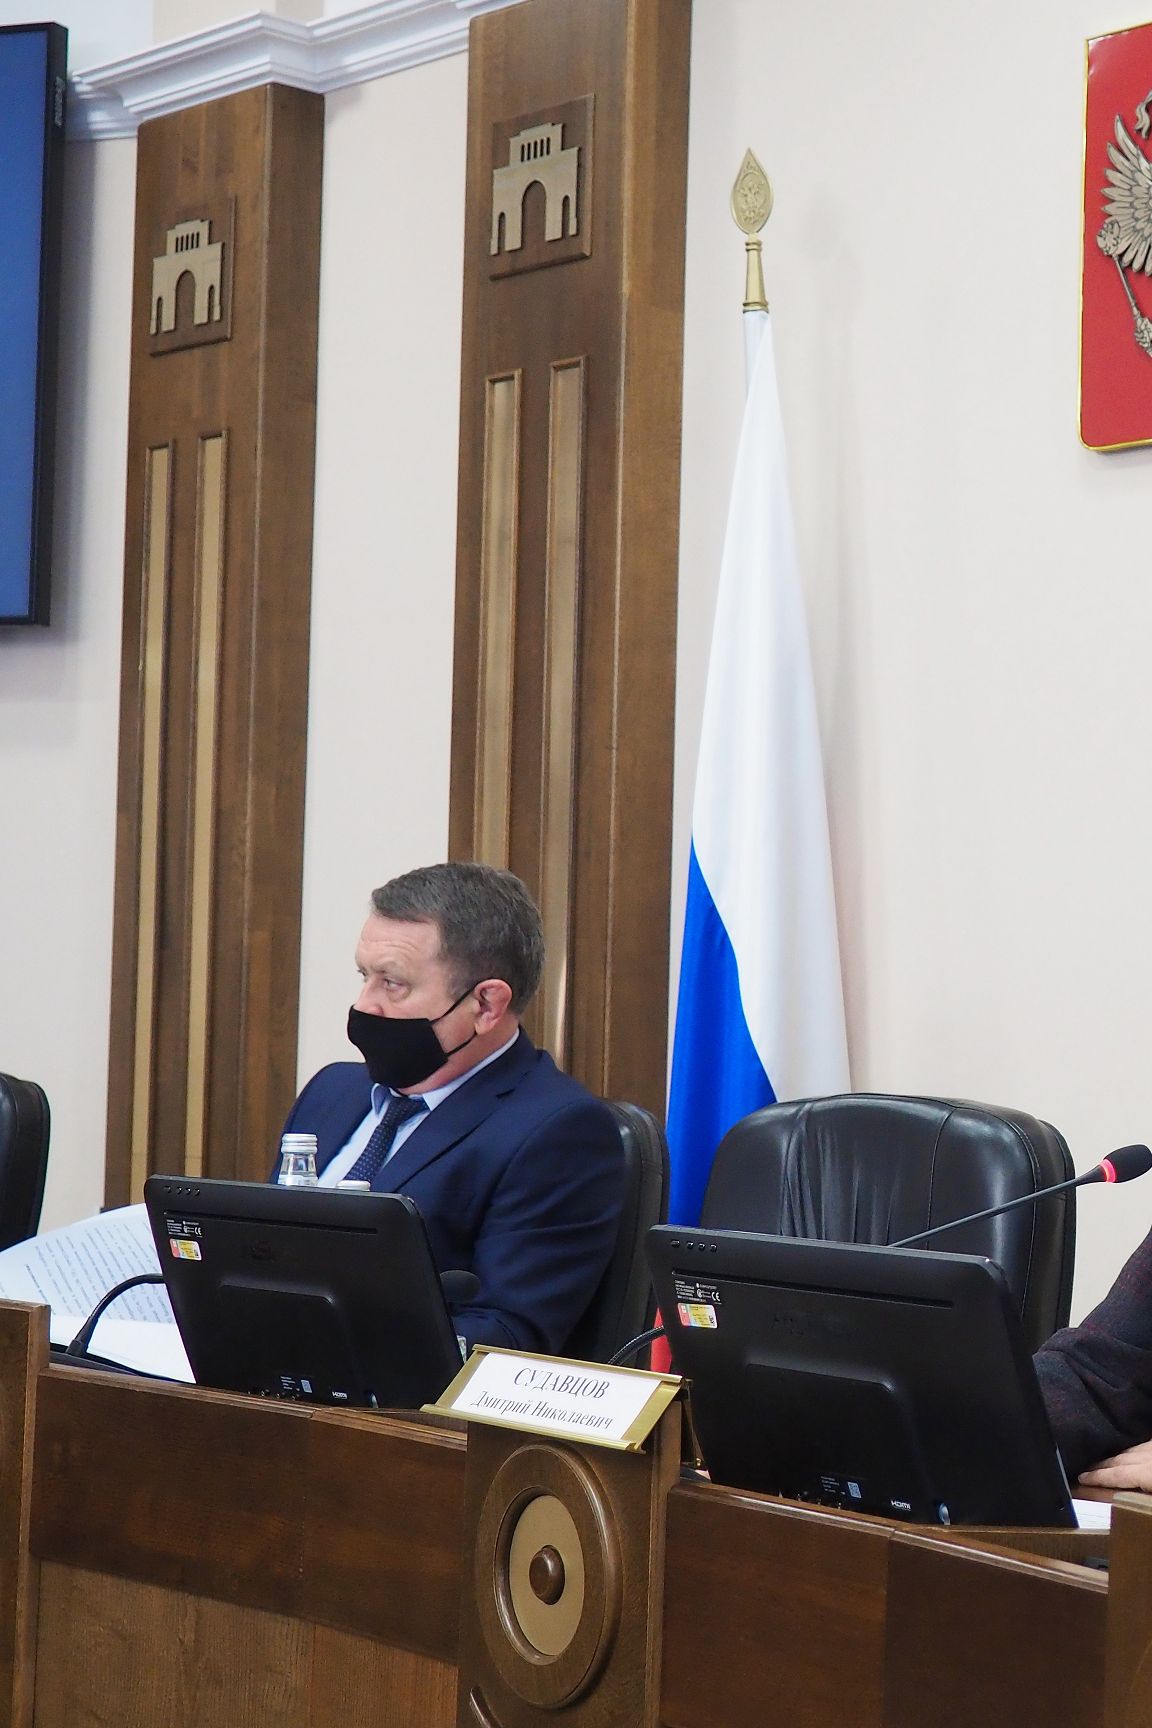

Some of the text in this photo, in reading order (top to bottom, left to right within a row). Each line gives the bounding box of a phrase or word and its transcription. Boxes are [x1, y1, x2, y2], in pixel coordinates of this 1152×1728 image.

[513, 1367, 611, 1399] СУДАВЦОВ
[470, 1390, 613, 1430] Дмитрий Николаевич
